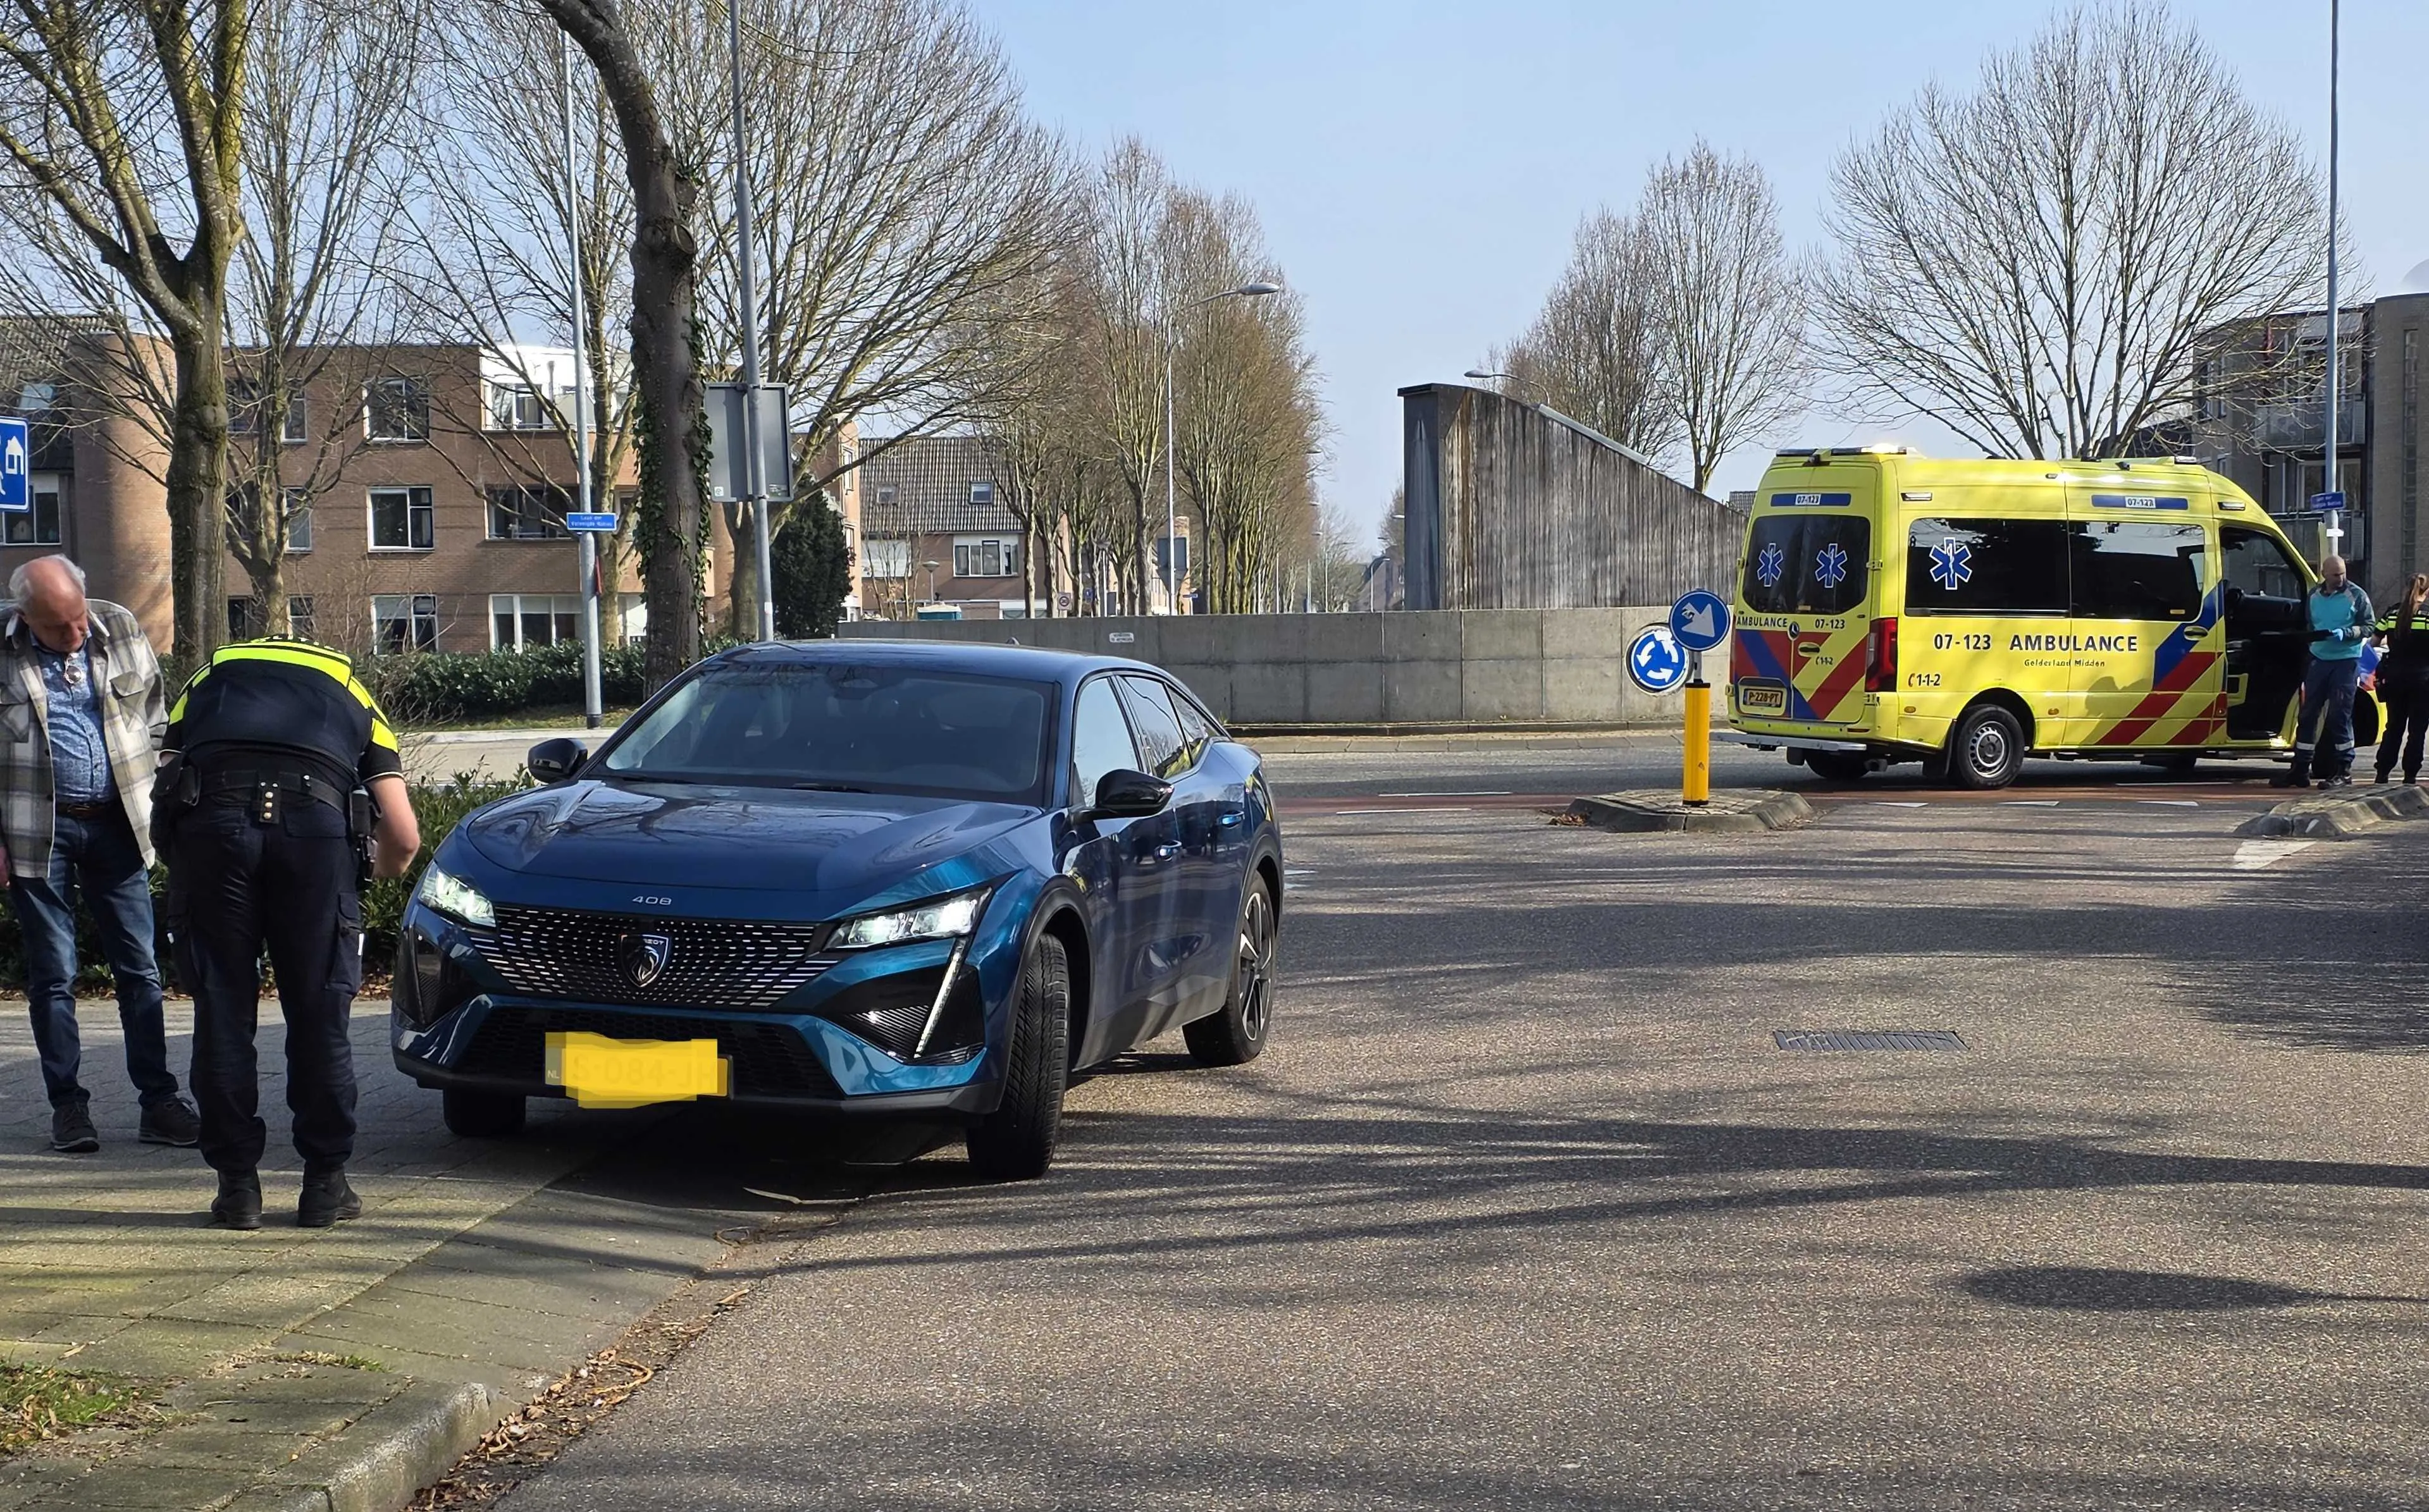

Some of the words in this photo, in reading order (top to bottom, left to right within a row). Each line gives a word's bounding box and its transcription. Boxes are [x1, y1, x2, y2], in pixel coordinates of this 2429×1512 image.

[1797, 495, 1820, 504] 07-123
[1737, 617, 1788, 628] AMBULANCE
[1815, 618, 1845, 629] 07-123
[1934, 634, 1991, 651] 07-123
[2009, 634, 2138, 652] AMBULANCE
[2024, 659, 2071, 667] Gelderland
[1917, 673, 1941, 686] 1-1-2
[633, 895, 672, 906] 408
[547, 1069, 560, 1079] NL
